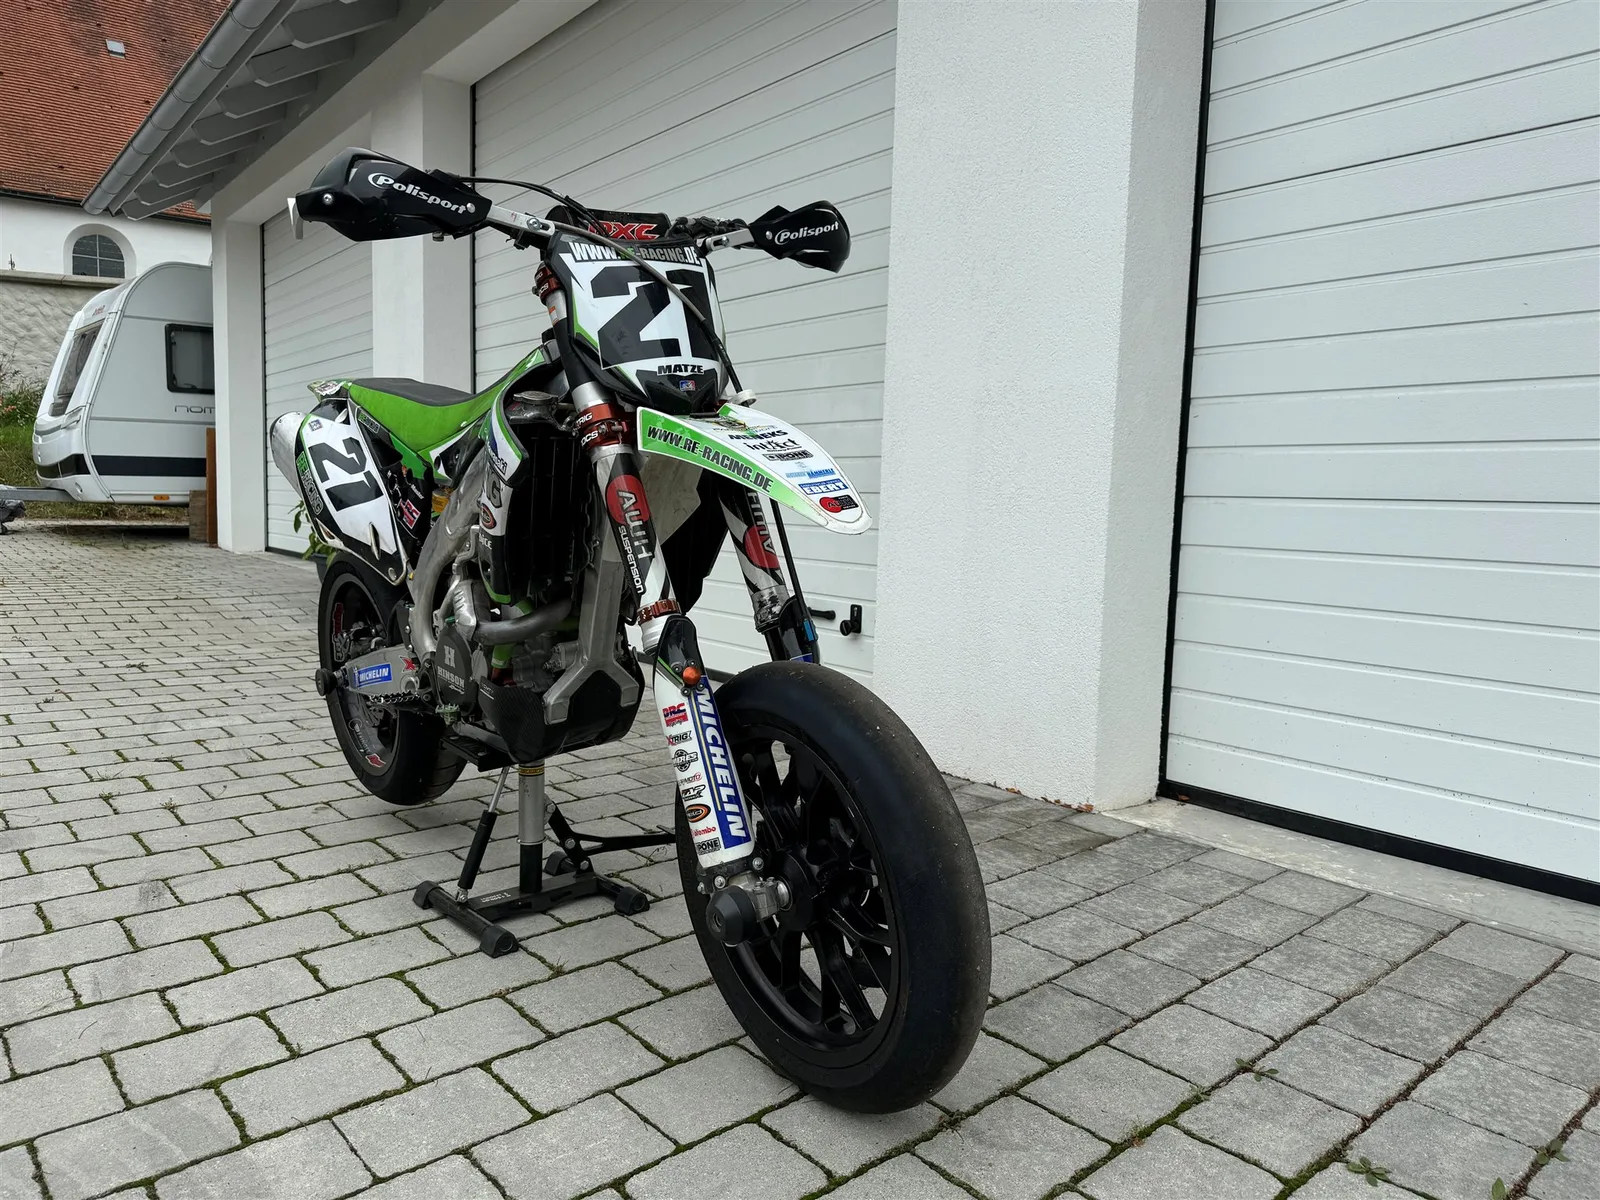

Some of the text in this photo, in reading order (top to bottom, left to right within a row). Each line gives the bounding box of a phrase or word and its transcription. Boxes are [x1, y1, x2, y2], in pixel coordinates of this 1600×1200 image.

[368, 172, 467, 215] Polisport
[774, 220, 840, 245] Polisport
[590, 265, 720, 369] 21
[657, 363, 705, 375] MATZE
[308, 437, 385, 512] 21
[647, 426, 774, 493] WWW.RE-RACING.DE
[802, 481, 846, 494] EBERT
[359, 667, 390, 682] MICHELIN
[697, 688, 746, 838] MICHELIN
